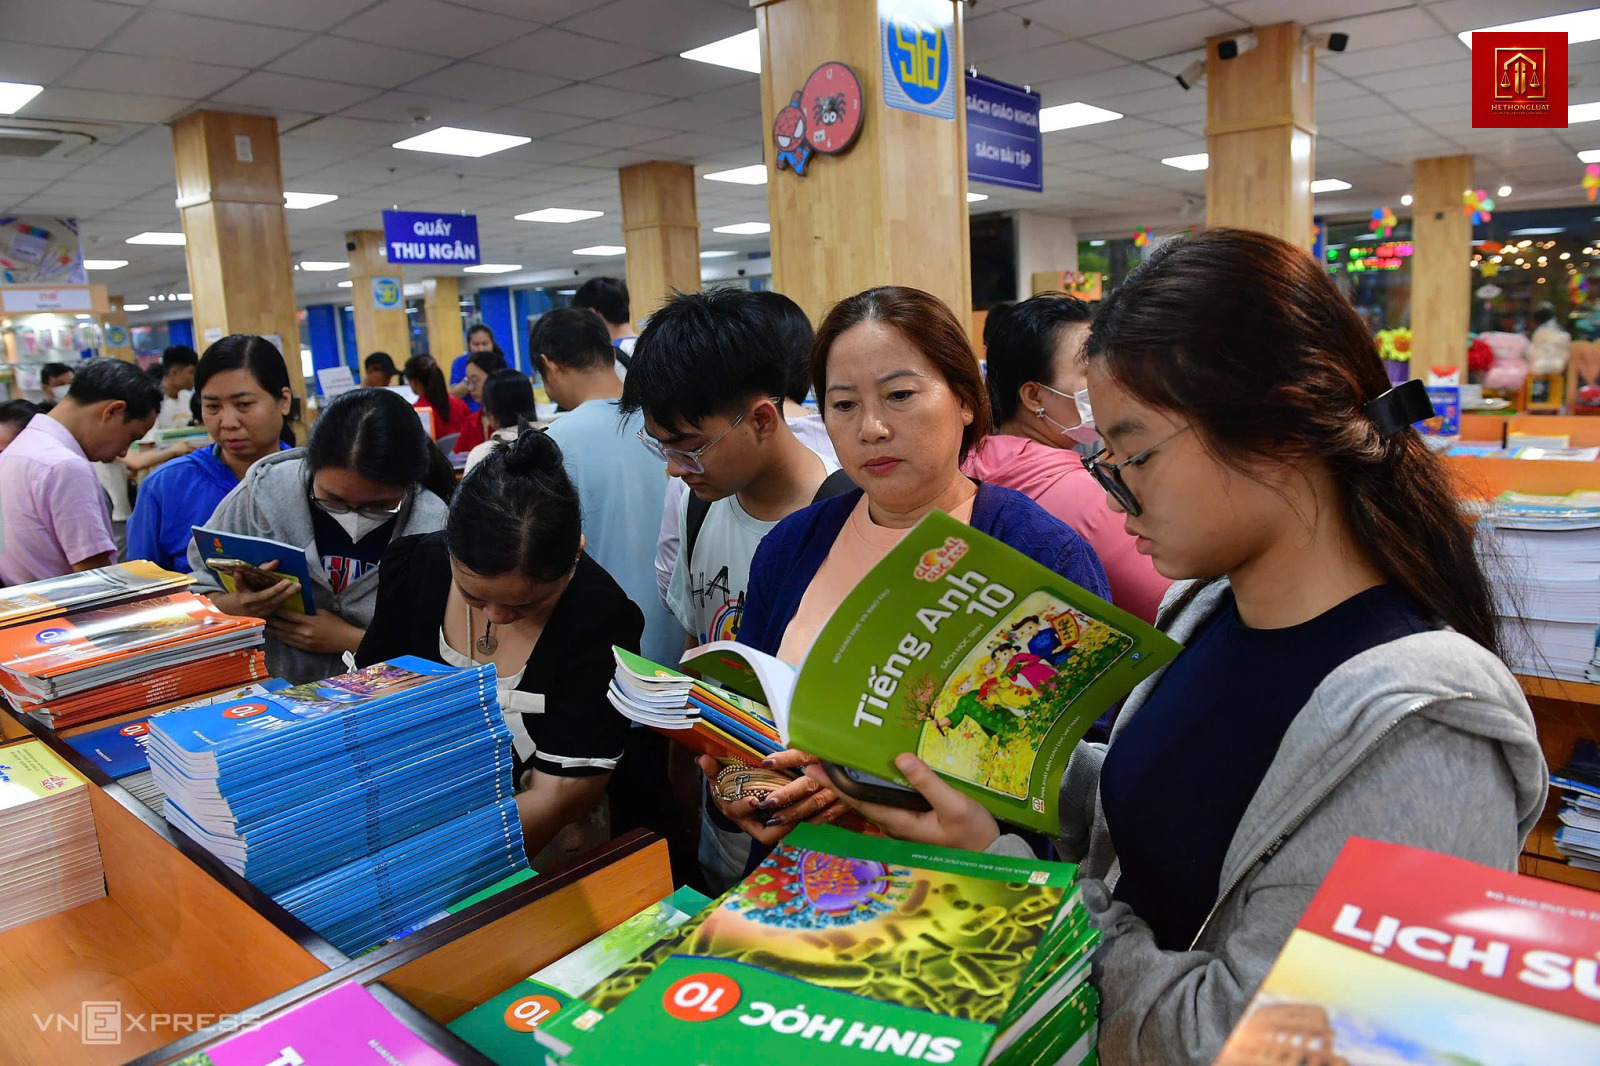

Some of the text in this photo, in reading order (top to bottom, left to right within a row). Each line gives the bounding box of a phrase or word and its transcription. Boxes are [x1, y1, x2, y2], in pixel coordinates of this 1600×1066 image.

[391, 240, 476, 260] THU NGÂN
[966, 583, 1015, 618] 10
[853, 570, 988, 727] Tiếng Anh
[229, 705, 259, 718] 10
[123, 724, 146, 736] 10
[1333, 903, 1510, 978] LỊCH
[674, 981, 725, 1013] 10
[513, 1000, 550, 1027] 10
[738, 1001, 962, 1064] SINH HỌC
